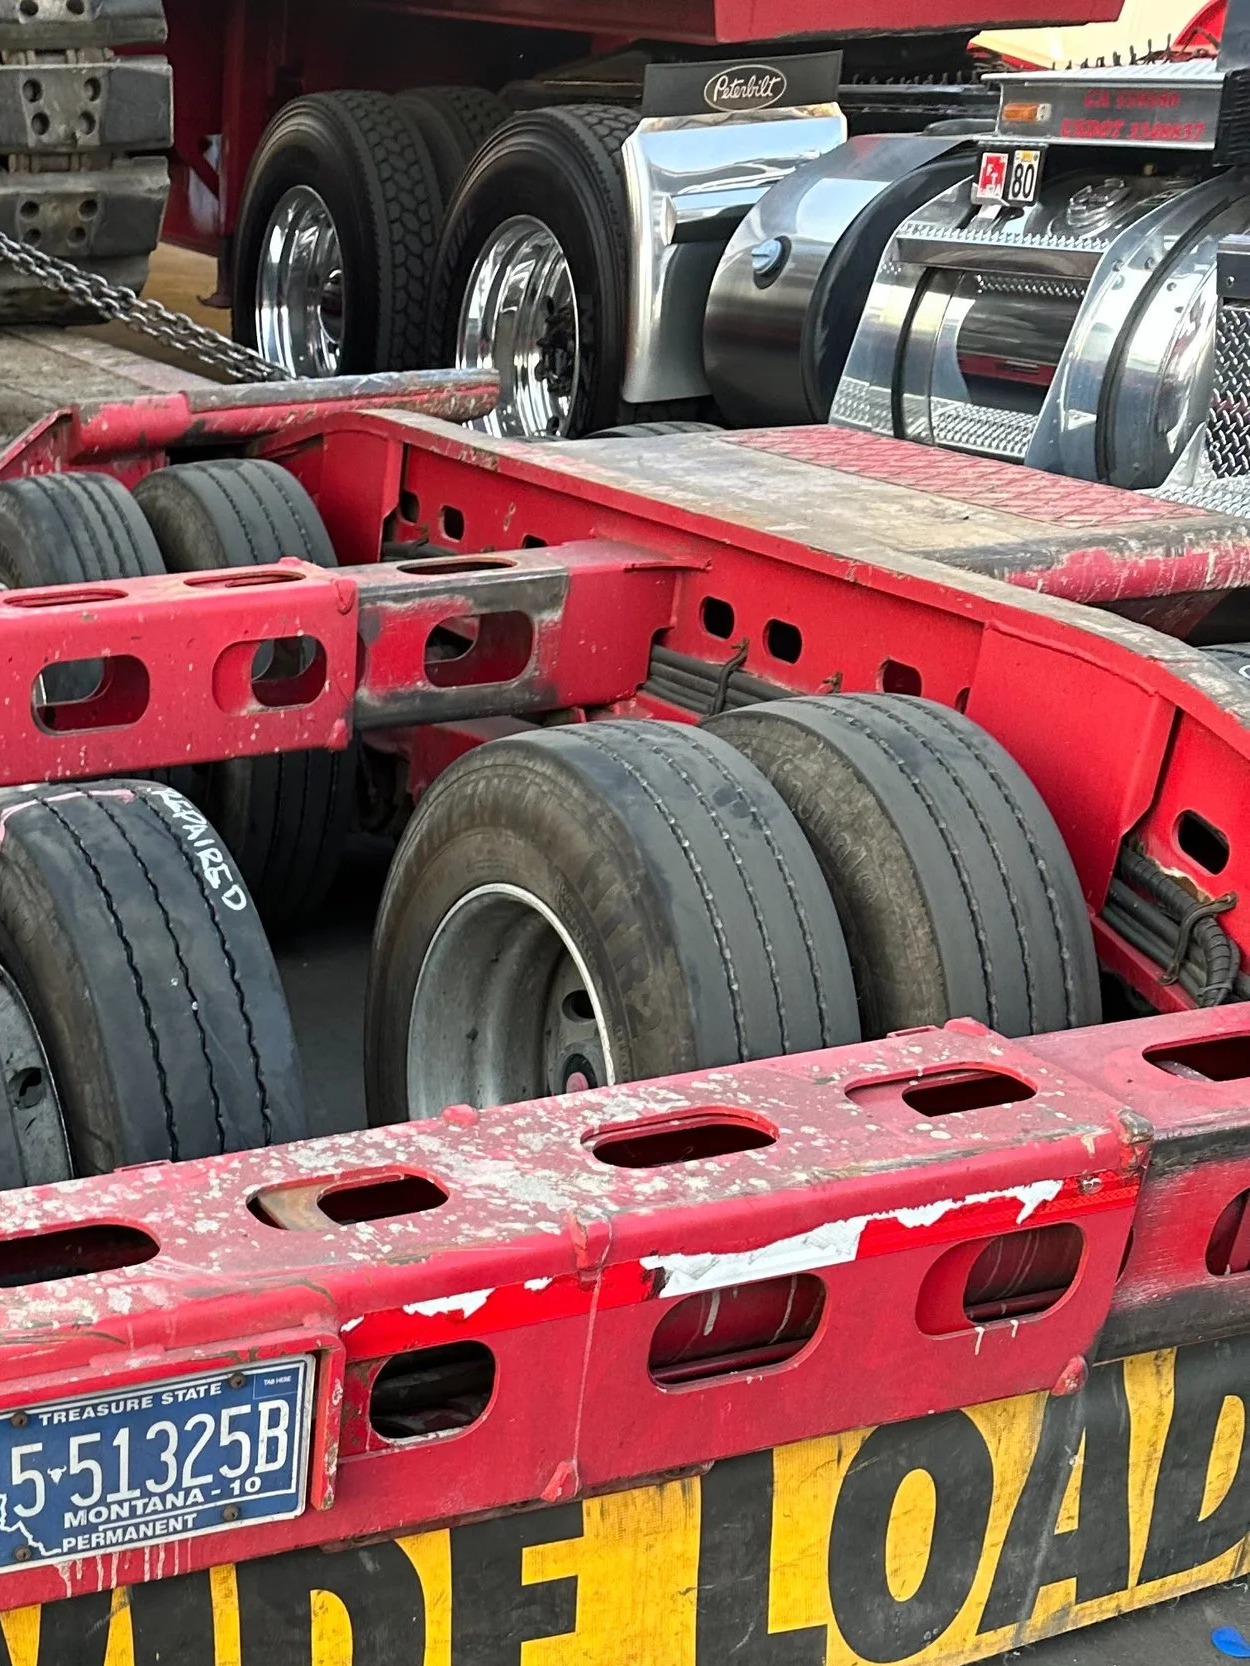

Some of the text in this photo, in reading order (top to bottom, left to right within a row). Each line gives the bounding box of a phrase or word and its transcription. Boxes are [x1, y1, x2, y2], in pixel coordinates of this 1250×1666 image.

[713, 74, 781, 102] Peterbilt
[1012, 163, 1035, 198] 80
[150, 787, 247, 911] REPAIRED
[275, 1376, 291, 1384] HERE
[38, 1382, 222, 1427] TREASURE STATE
[63, 1492, 204, 1529] MONTANA
[230, 1477, 261, 1496] 10
[62, 1513, 198, 1552] PERMANENT
